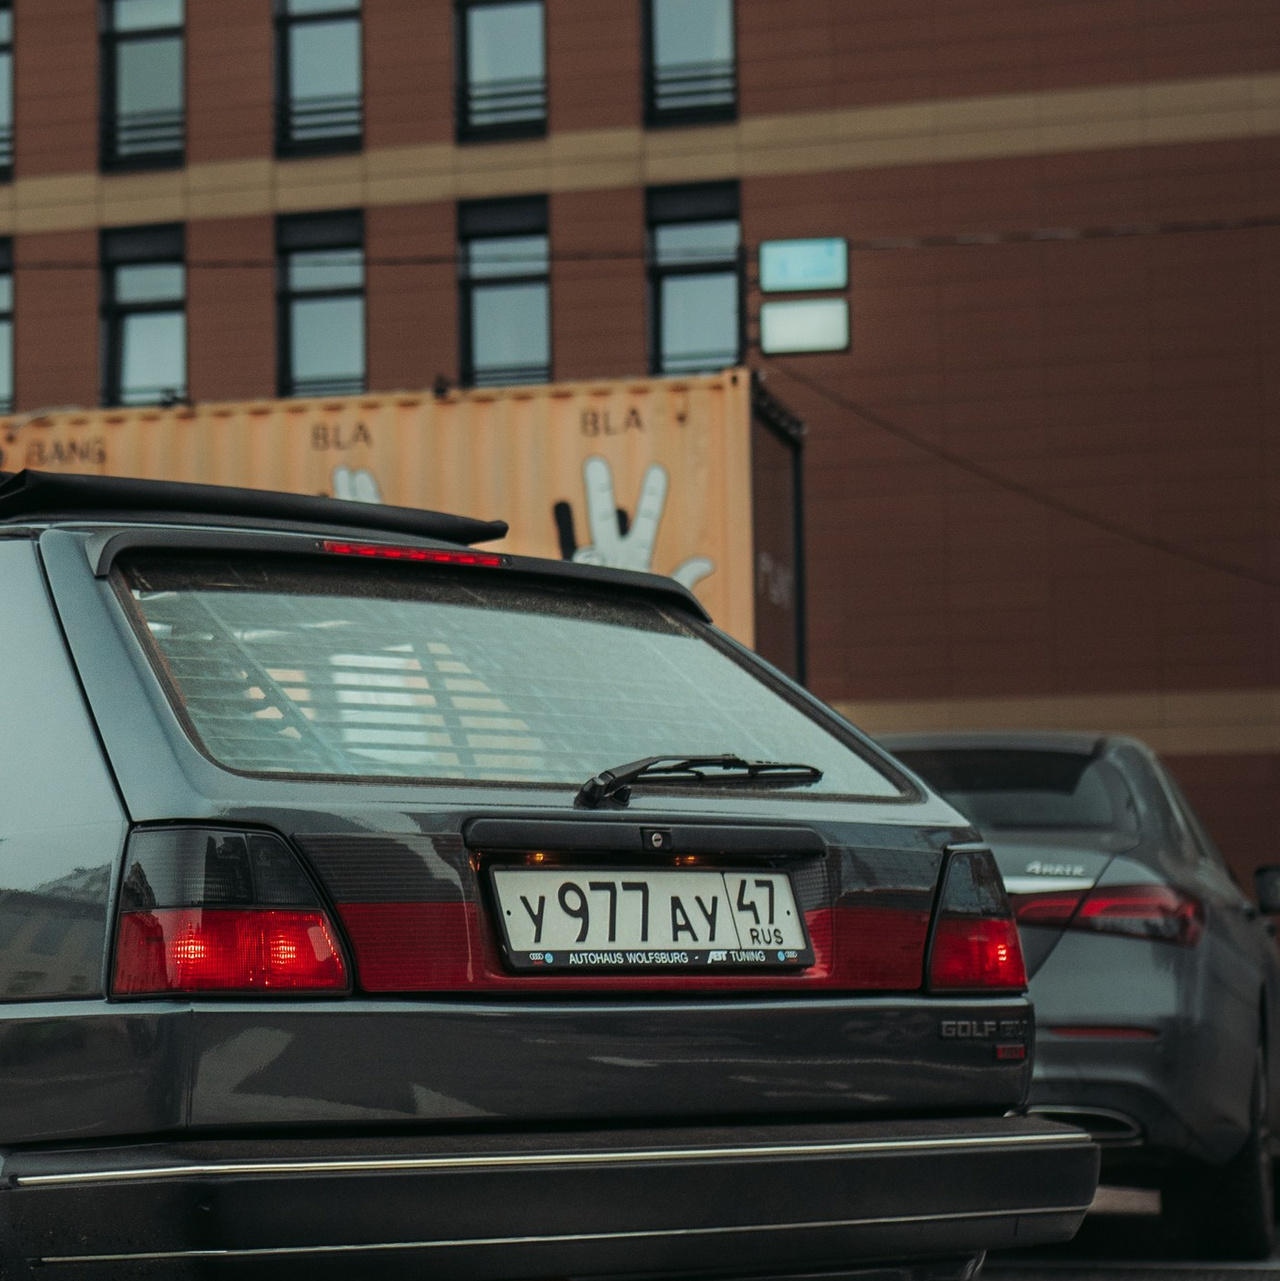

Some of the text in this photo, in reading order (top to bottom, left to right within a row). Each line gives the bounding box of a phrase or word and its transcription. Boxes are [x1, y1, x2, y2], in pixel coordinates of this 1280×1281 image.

[580, 406, 645, 438] BLA
[310, 421, 373, 452] BLA
[736, 879, 775, 925] 47
[749, 927, 784, 946] RUS
[569, 952, 624, 965] AUTOHAUS
[626, 952, 689, 964] WOLFSBURG
[730, 950, 766, 963] TUNING
[941, 1020, 997, 1037] GOLF
